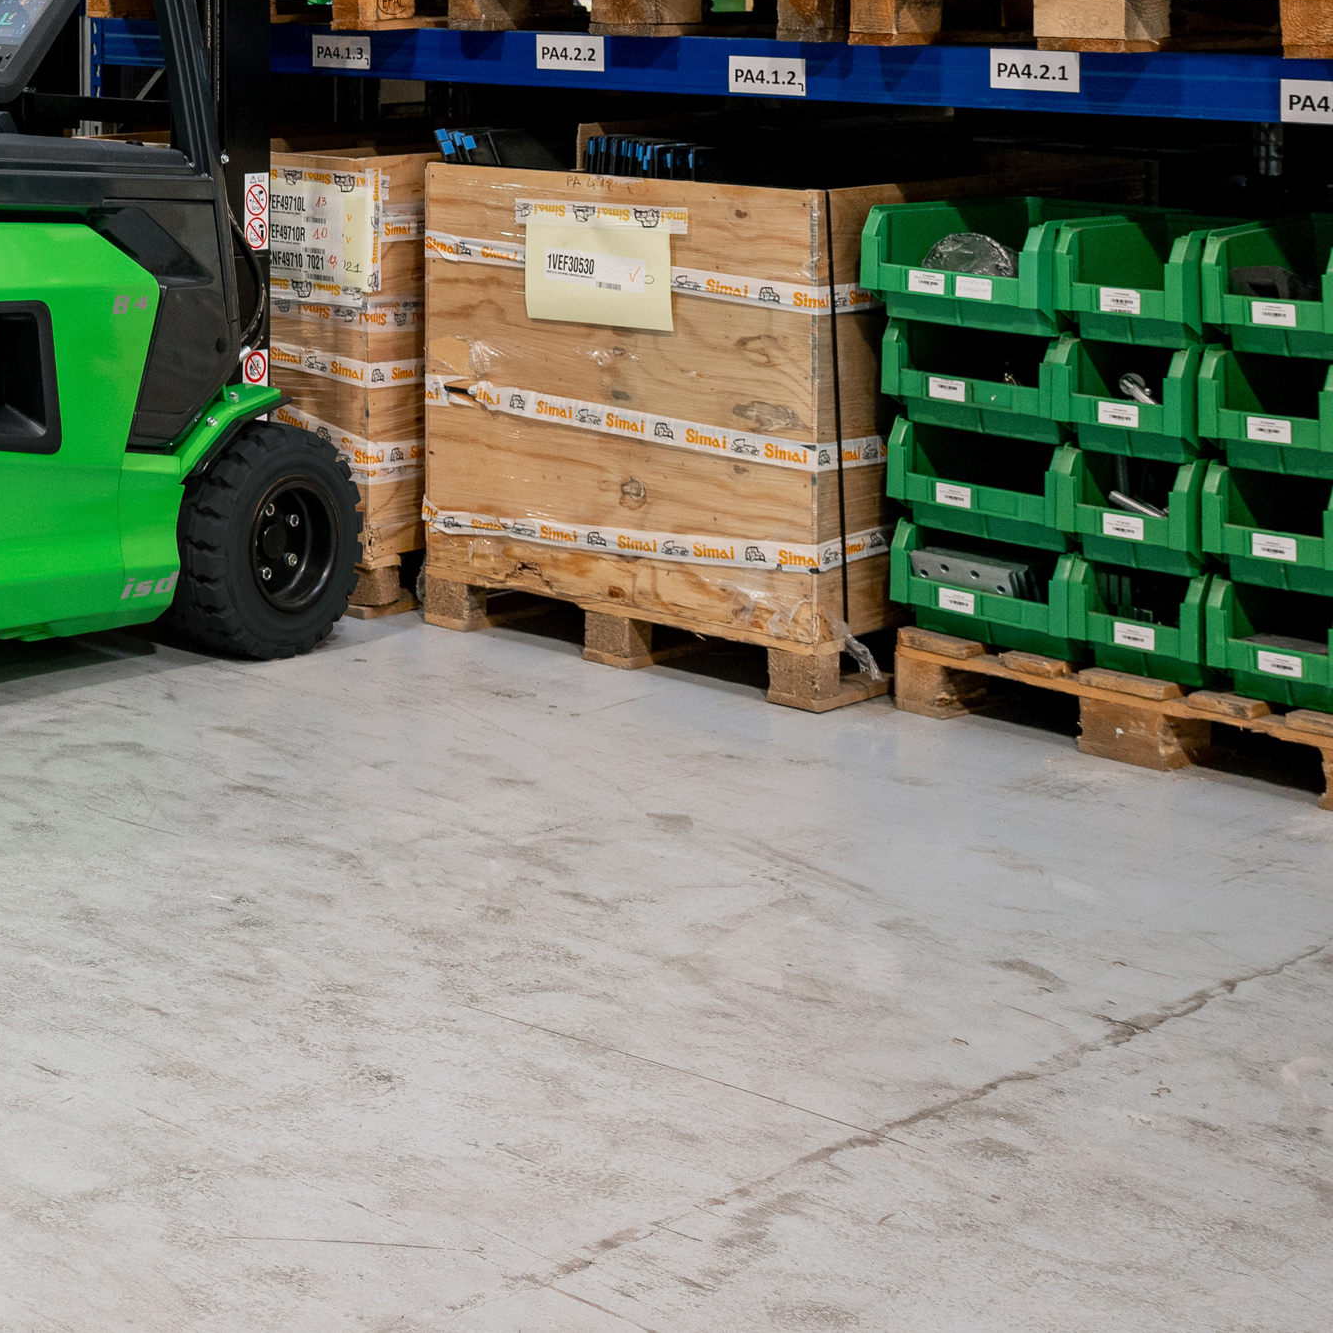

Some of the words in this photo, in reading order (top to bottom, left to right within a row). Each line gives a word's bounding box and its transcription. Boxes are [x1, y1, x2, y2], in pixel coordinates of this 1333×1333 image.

[541, 46, 597, 62] PA4.2.2
[996, 61, 1069, 82] PA4.2.1
[307, 255, 324, 270] 7021
[547, 253, 595, 276] 1VEF30530
[120, 570, 179, 599] isd
